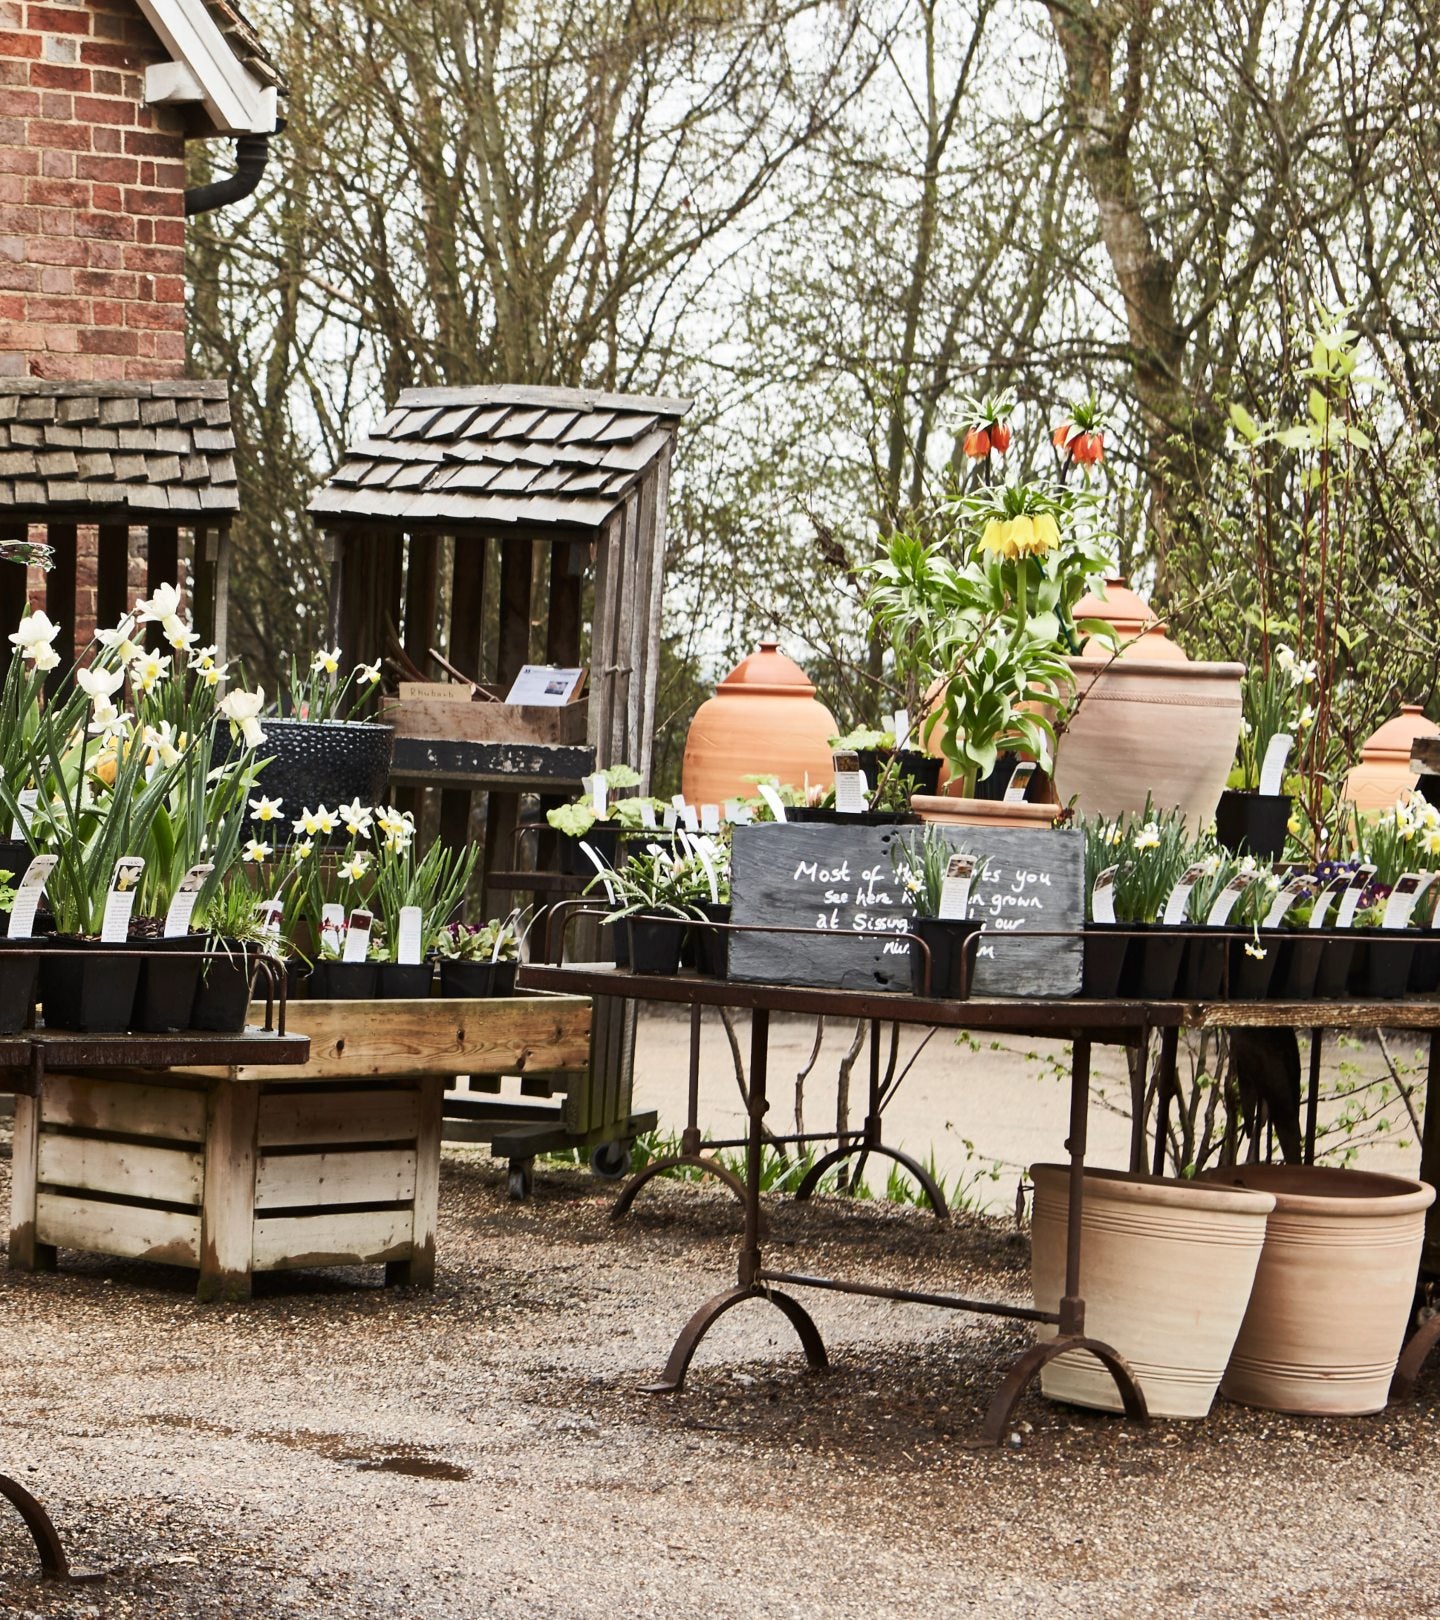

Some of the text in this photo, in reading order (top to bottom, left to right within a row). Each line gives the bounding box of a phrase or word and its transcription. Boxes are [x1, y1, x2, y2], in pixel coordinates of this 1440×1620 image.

[794, 860, 851, 882] Most
[861, 864, 885, 898] of
[1011, 870, 1052, 893] you
[823, 889, 849, 904] see
[855, 887, 893, 907] here
[989, 894, 1043, 915] grown
[816, 908, 841, 929] at
[995, 918, 1026, 930] our
